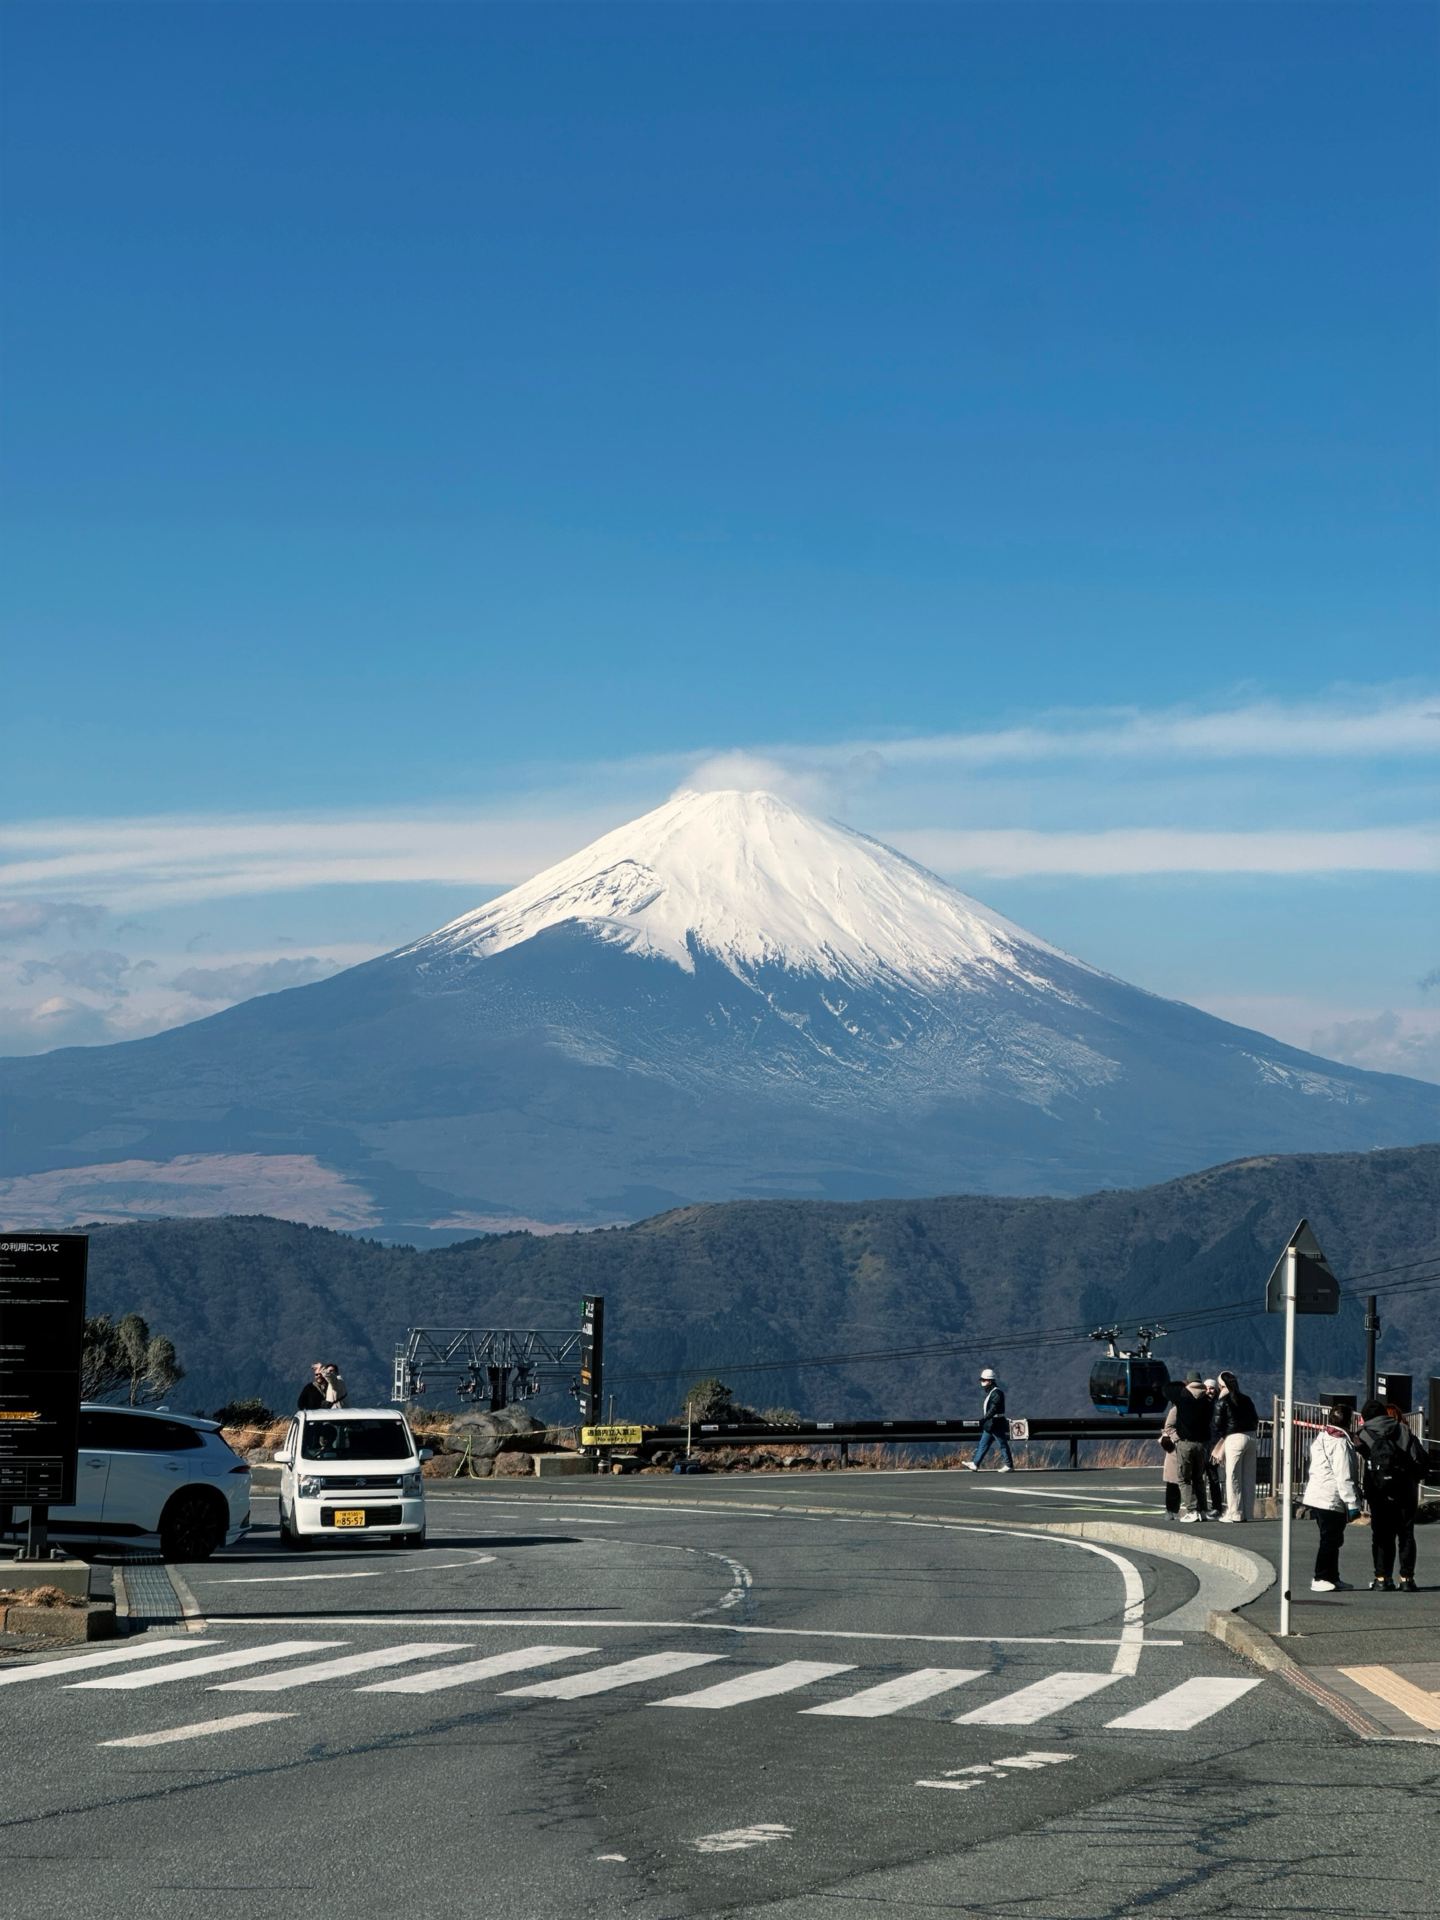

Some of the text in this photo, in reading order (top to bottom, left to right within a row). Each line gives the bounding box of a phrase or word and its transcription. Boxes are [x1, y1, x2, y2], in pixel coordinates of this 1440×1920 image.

[0, 1242, 60, 1252] の利用について
